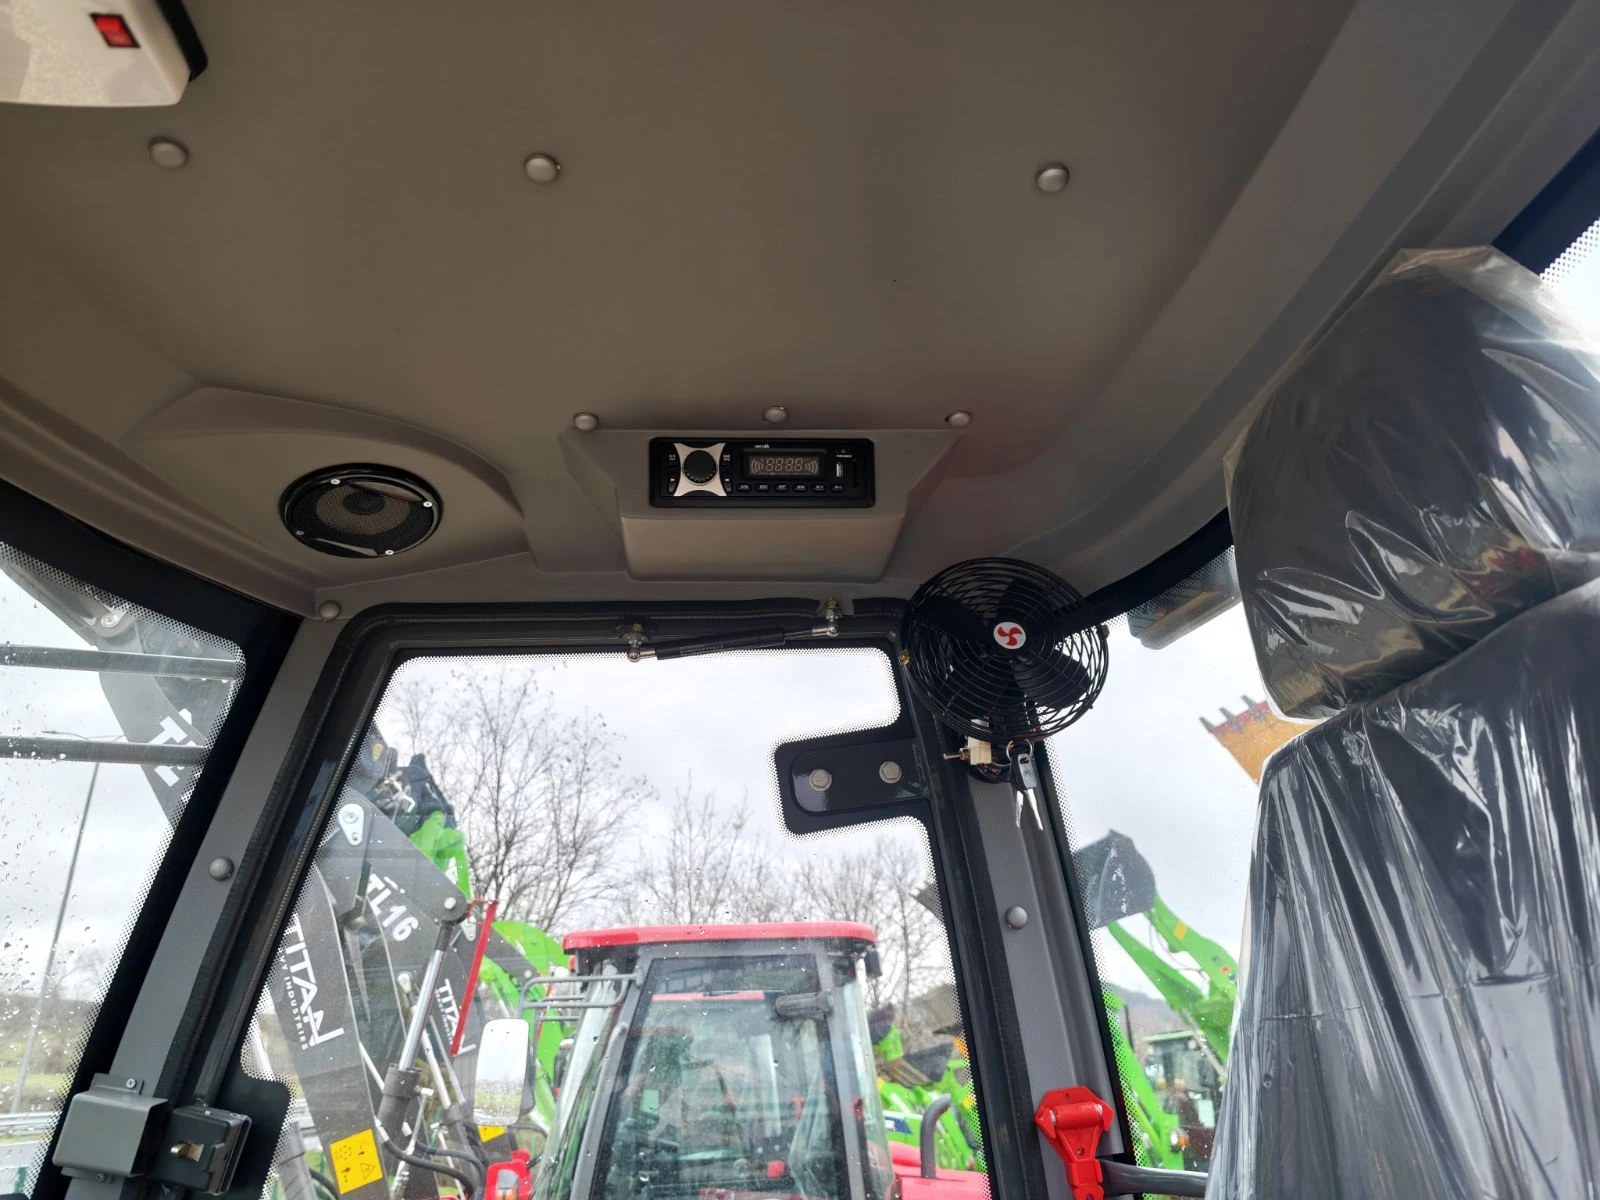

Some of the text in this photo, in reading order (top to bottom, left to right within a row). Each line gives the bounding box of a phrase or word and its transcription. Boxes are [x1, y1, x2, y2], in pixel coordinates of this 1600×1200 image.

[366, 873, 419, 942] TL16
[283, 912, 345, 1047] TITAN
[284, 976, 309, 1051] INDUSTRIES
